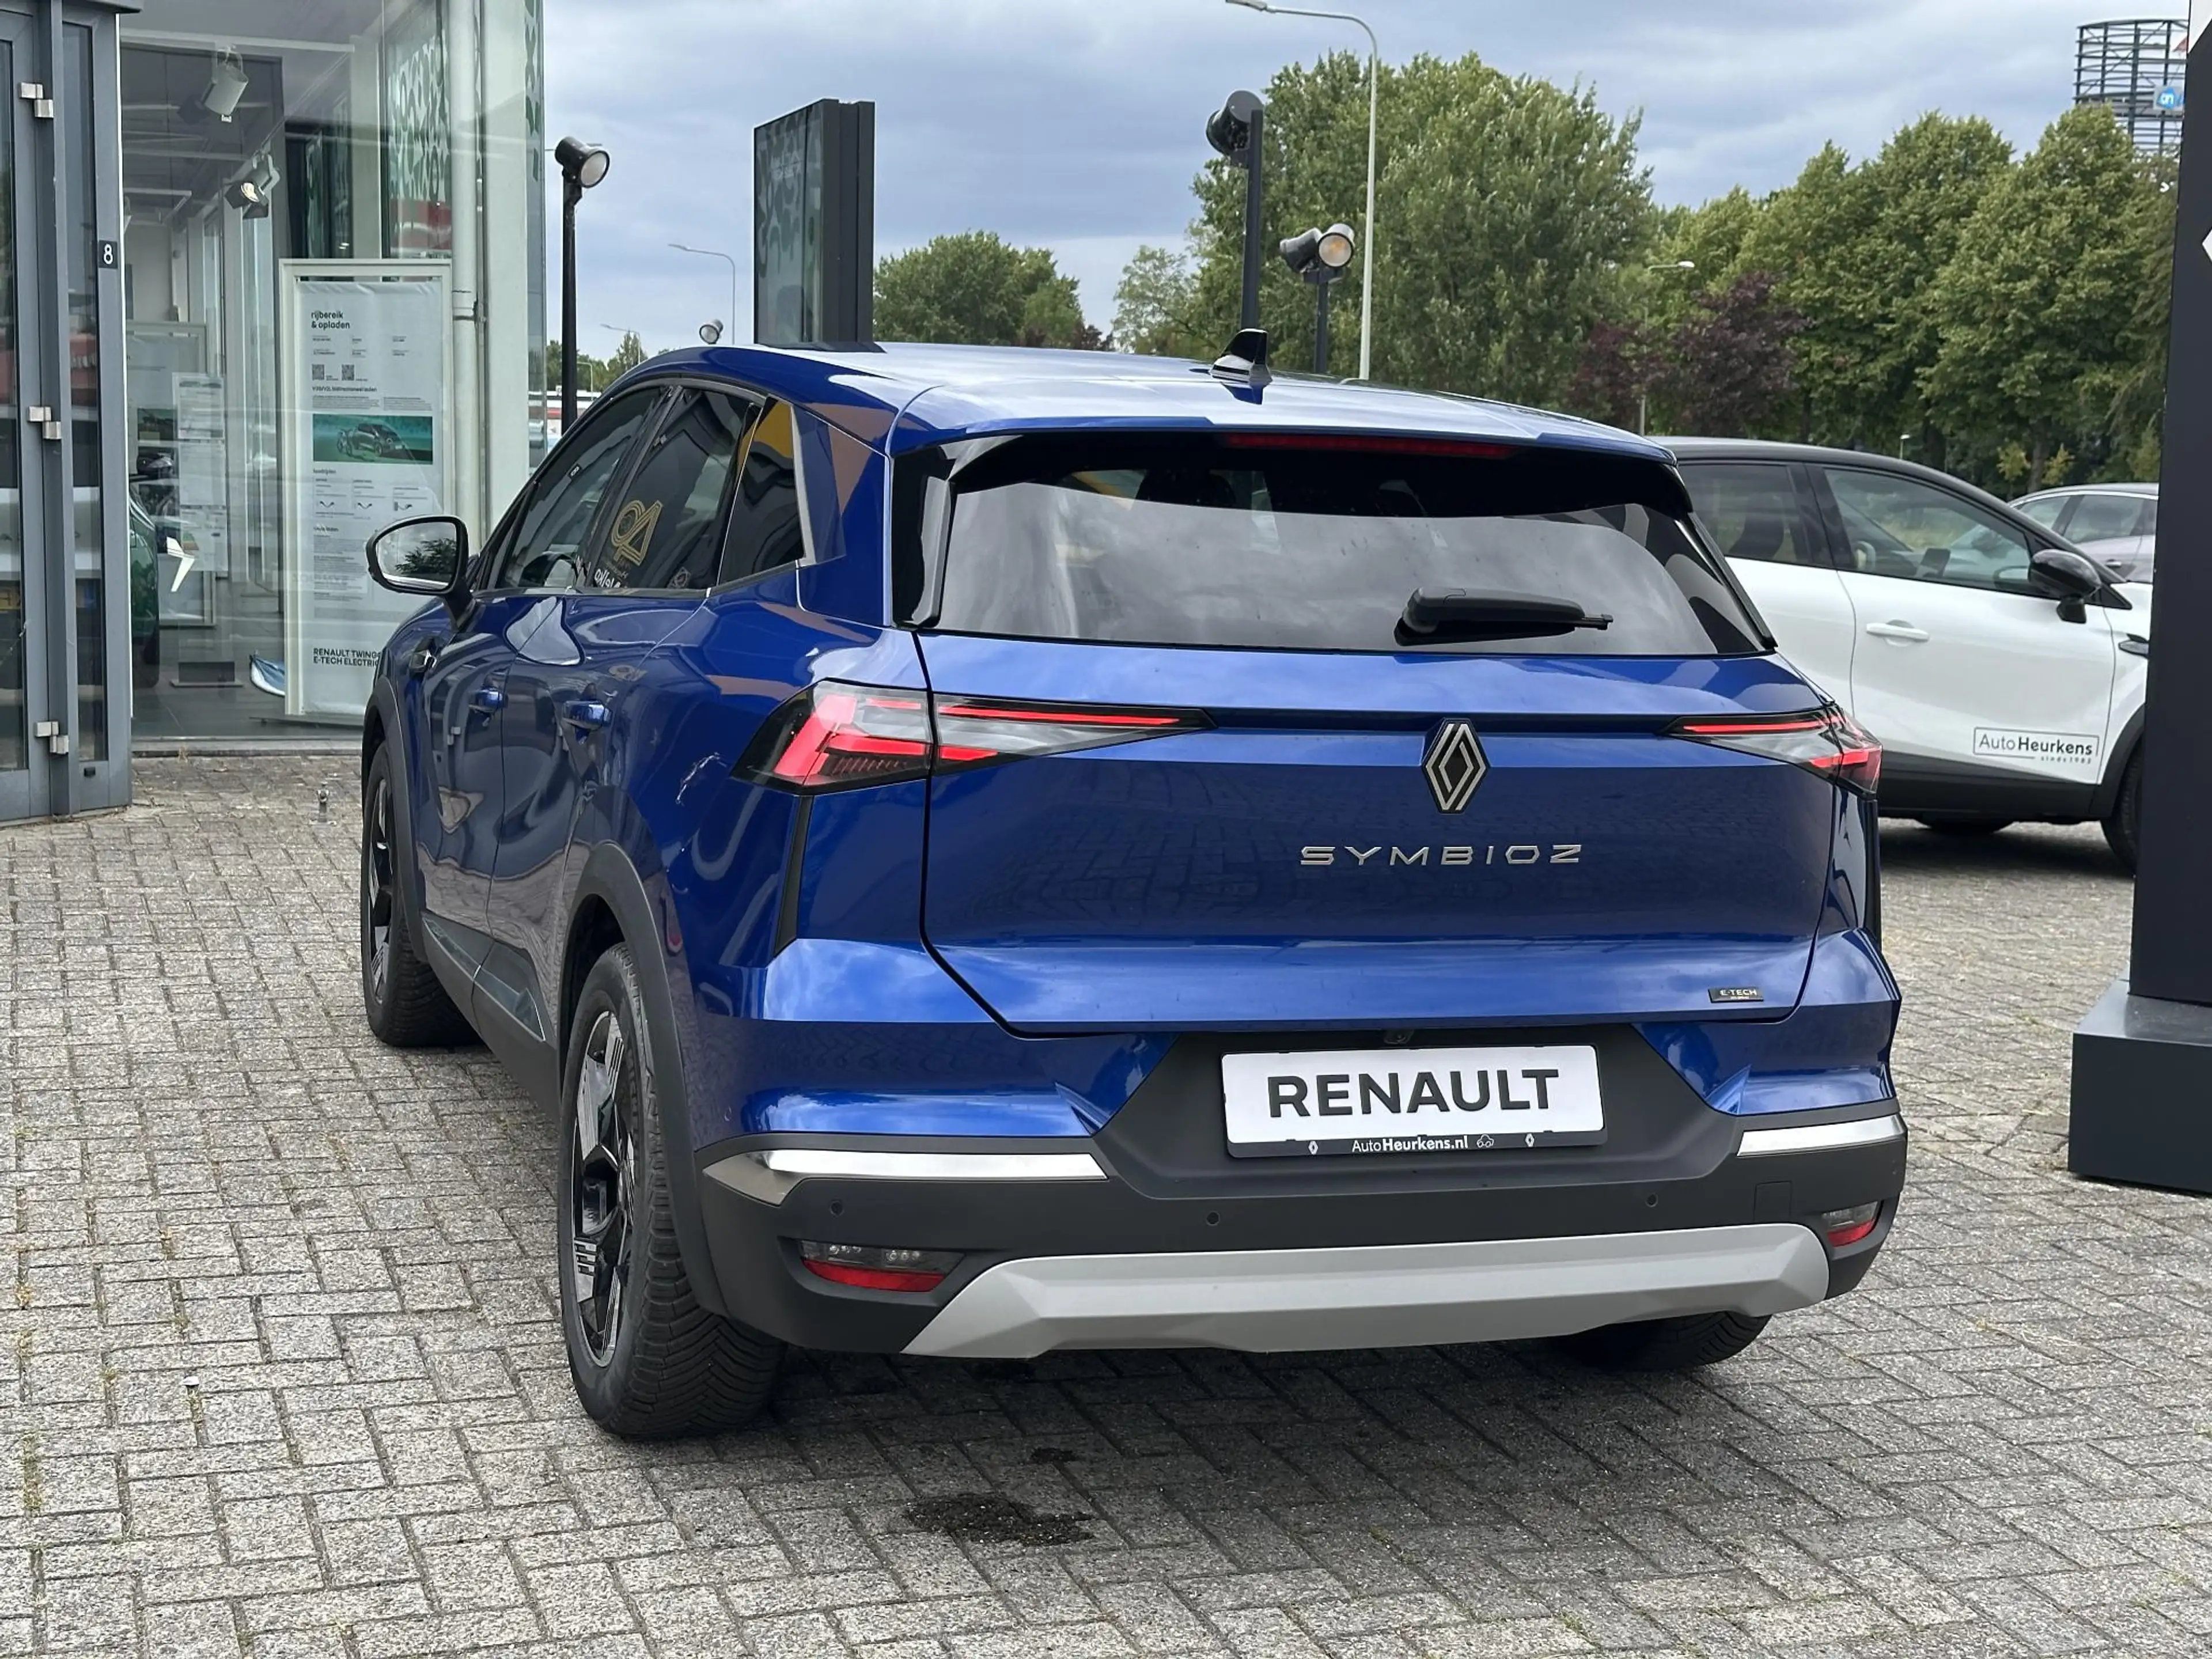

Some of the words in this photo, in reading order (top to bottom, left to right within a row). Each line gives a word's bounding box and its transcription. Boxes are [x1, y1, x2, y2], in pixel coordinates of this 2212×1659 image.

[104, 244, 113, 264] 8
[311, 310, 343, 320] rijbereik
[318, 320, 350, 331] opladen
[313, 647, 350, 657] RENAULT
[313, 656, 343, 665] E-TECH
[1979, 733, 2016, 750] Auto
[2018, 736, 2093, 756] Heurkens
[1300, 844, 1582, 866] SYMBIOZ
[1267, 1069, 1559, 1118] RENAULT
[1352, 1135, 1468, 1152] AutoHeurkens.nl
